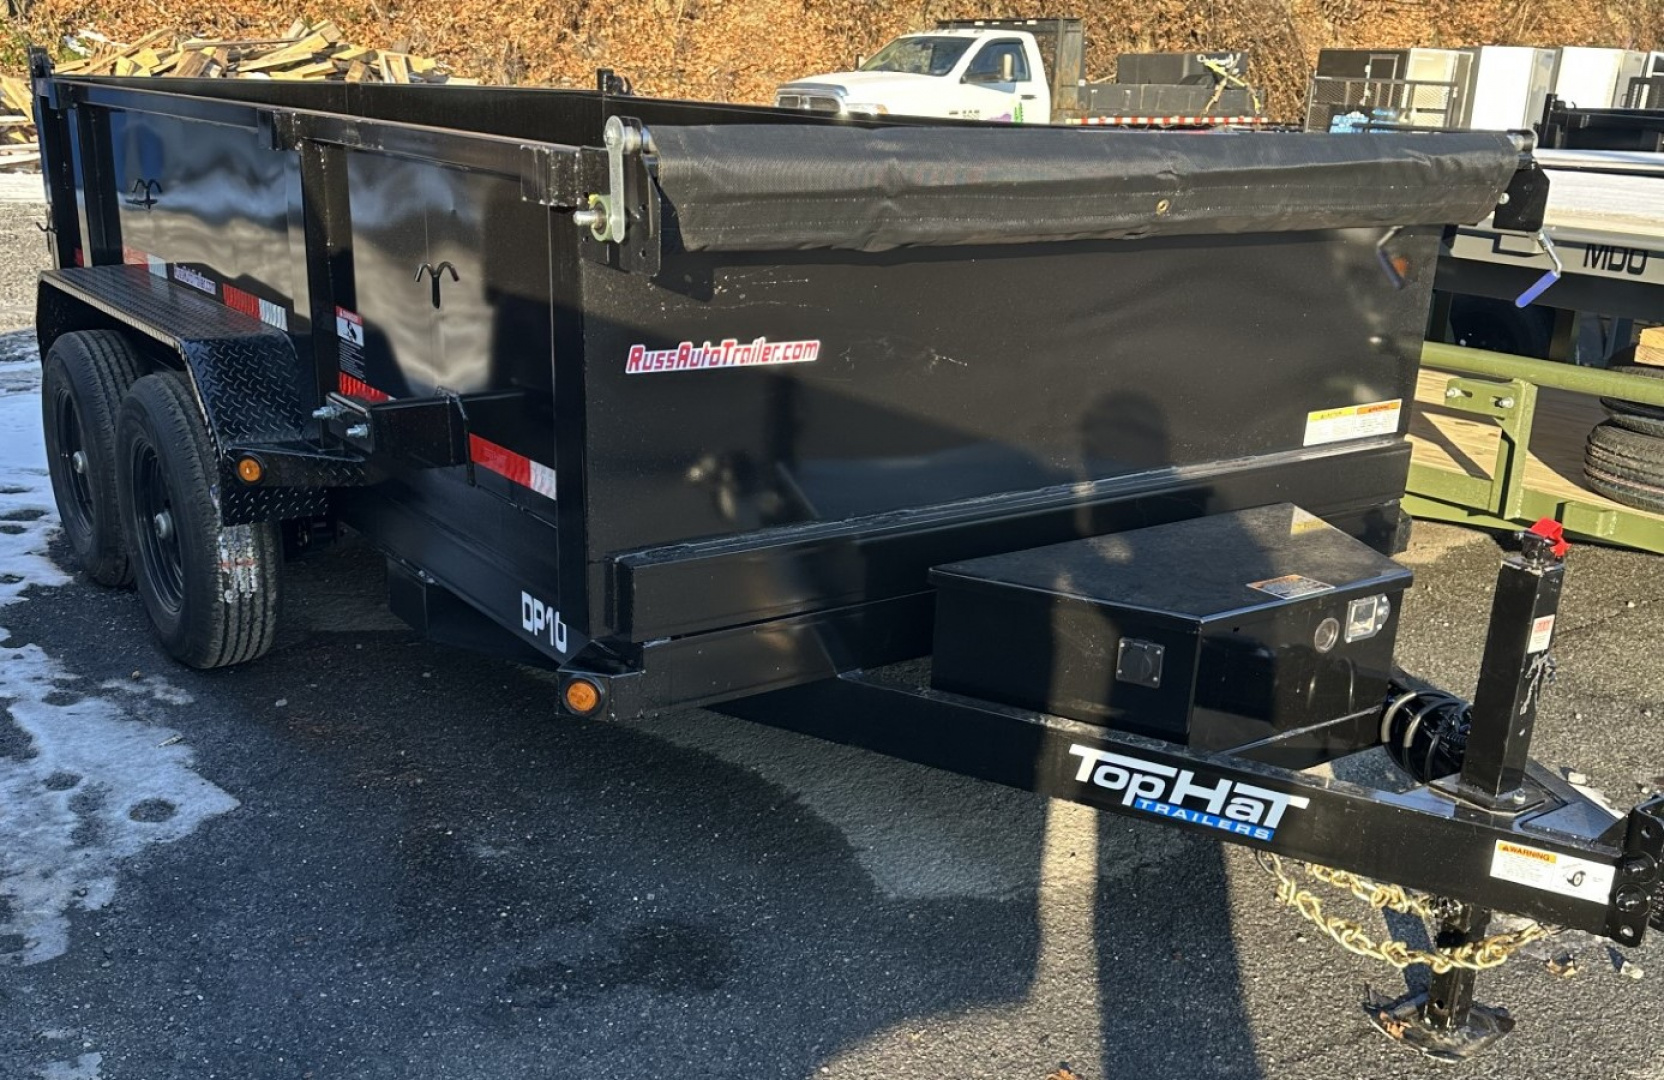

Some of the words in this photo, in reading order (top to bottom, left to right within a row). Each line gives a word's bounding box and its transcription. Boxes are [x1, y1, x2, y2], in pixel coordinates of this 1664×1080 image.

[627, 338, 819, 372] RussAutoTrailer.com
[522, 590, 567, 654] DP10
[1138, 800, 1270, 838] TRAILERS
[1510, 847, 1550, 861] WARNING
